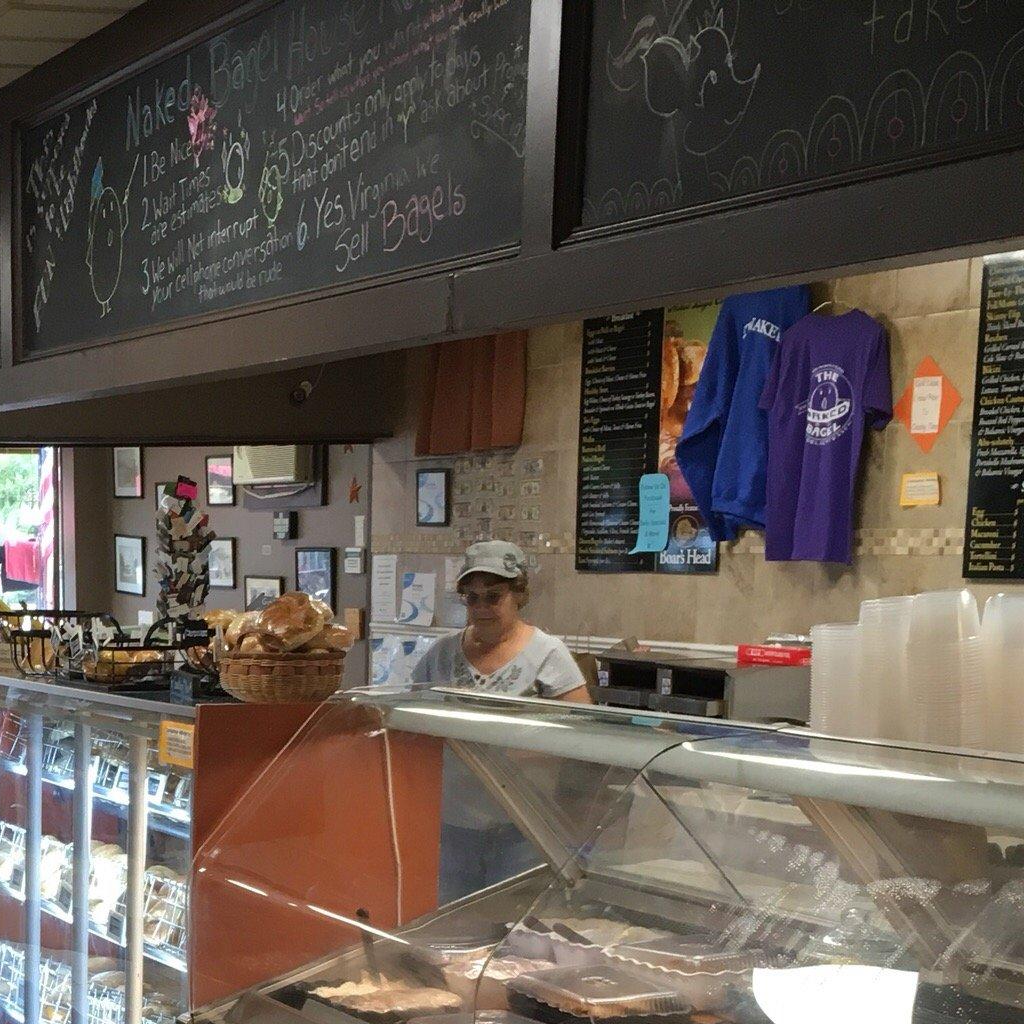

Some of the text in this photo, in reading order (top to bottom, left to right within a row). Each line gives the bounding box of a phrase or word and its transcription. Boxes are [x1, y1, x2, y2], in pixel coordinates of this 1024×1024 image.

[127, 54, 191, 151] Naked
[209, 27, 277, 113] Bagel
[277, 86, 286, 122] 4
[150, 150, 166, 182] Be
[334, 170, 466, 273] Sell Bagels
[141, 258, 150, 296] 3
[207, 208, 259, 249] interrupt
[814, 370, 840, 383] THE
[805, 422, 842, 438] BAGEL
[659, 549, 712, 564] Boar's Head
